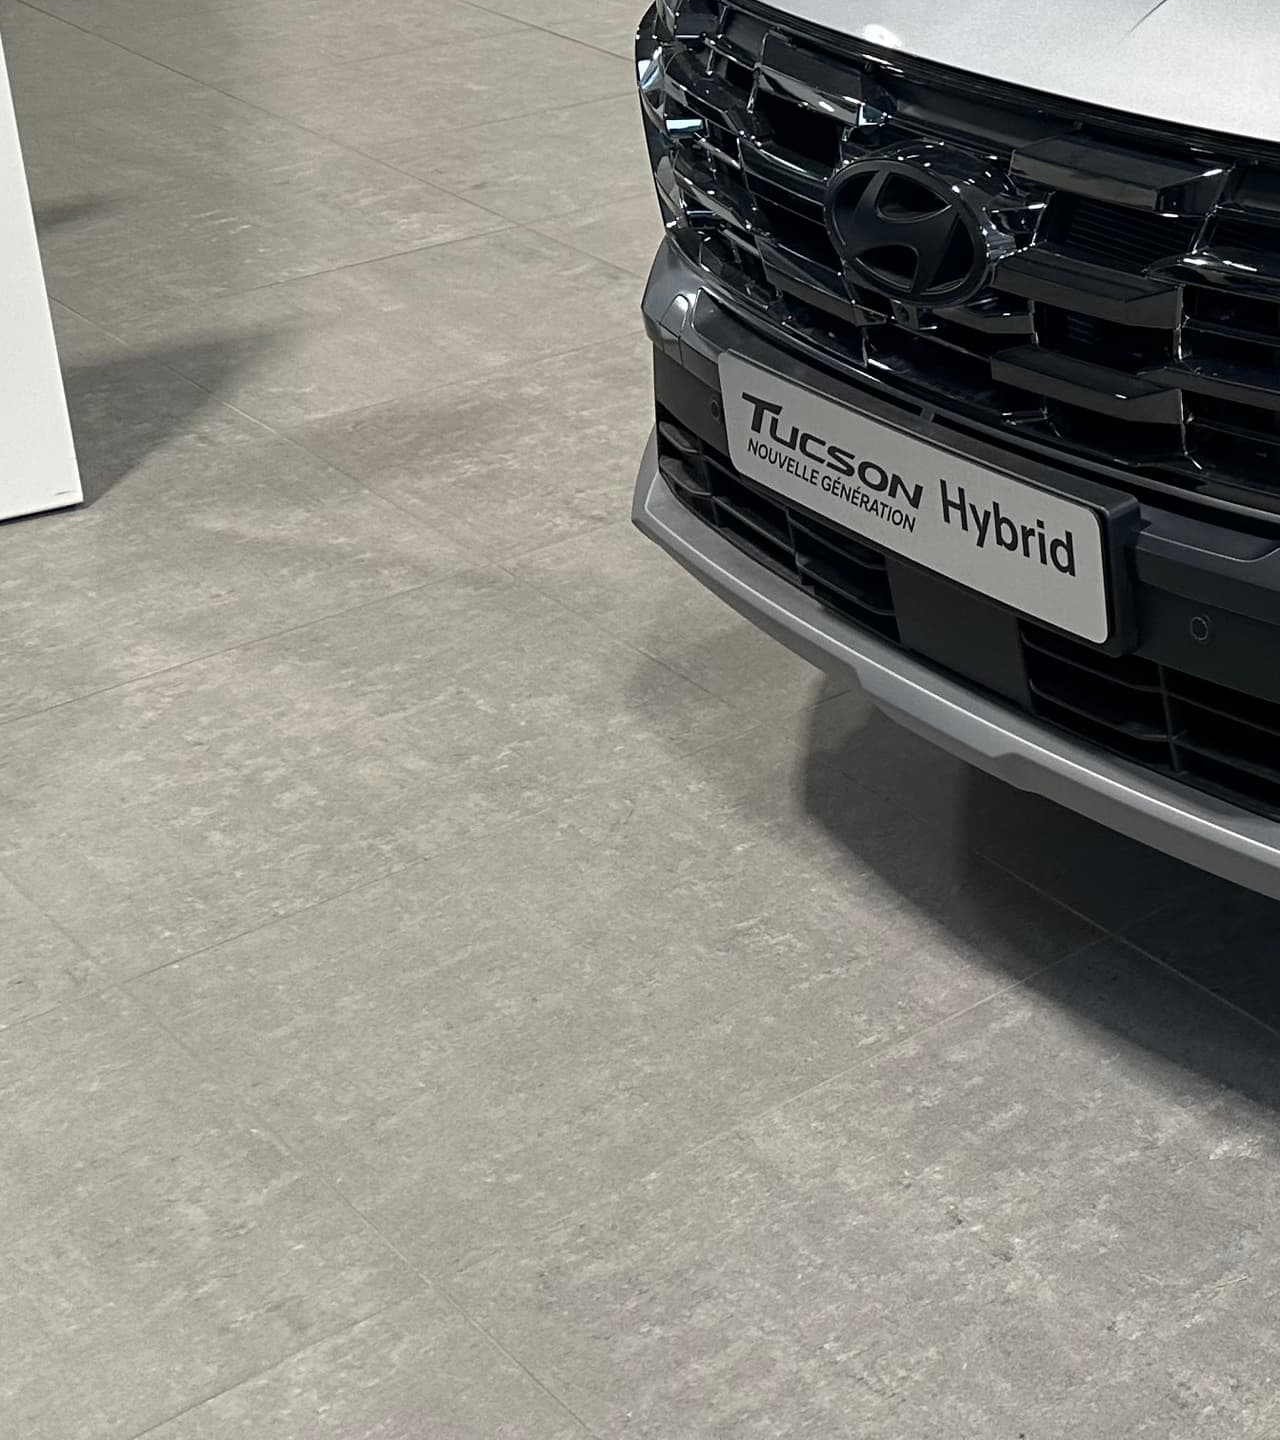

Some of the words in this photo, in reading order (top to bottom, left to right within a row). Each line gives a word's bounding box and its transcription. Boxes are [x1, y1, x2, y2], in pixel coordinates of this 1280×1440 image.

[742, 392, 923, 509] TUCSON
[940, 479, 1075, 577] Hybrid
[747, 437, 818, 485] NOUVELLE
[821, 468, 916, 533] GÉNÉRATION
